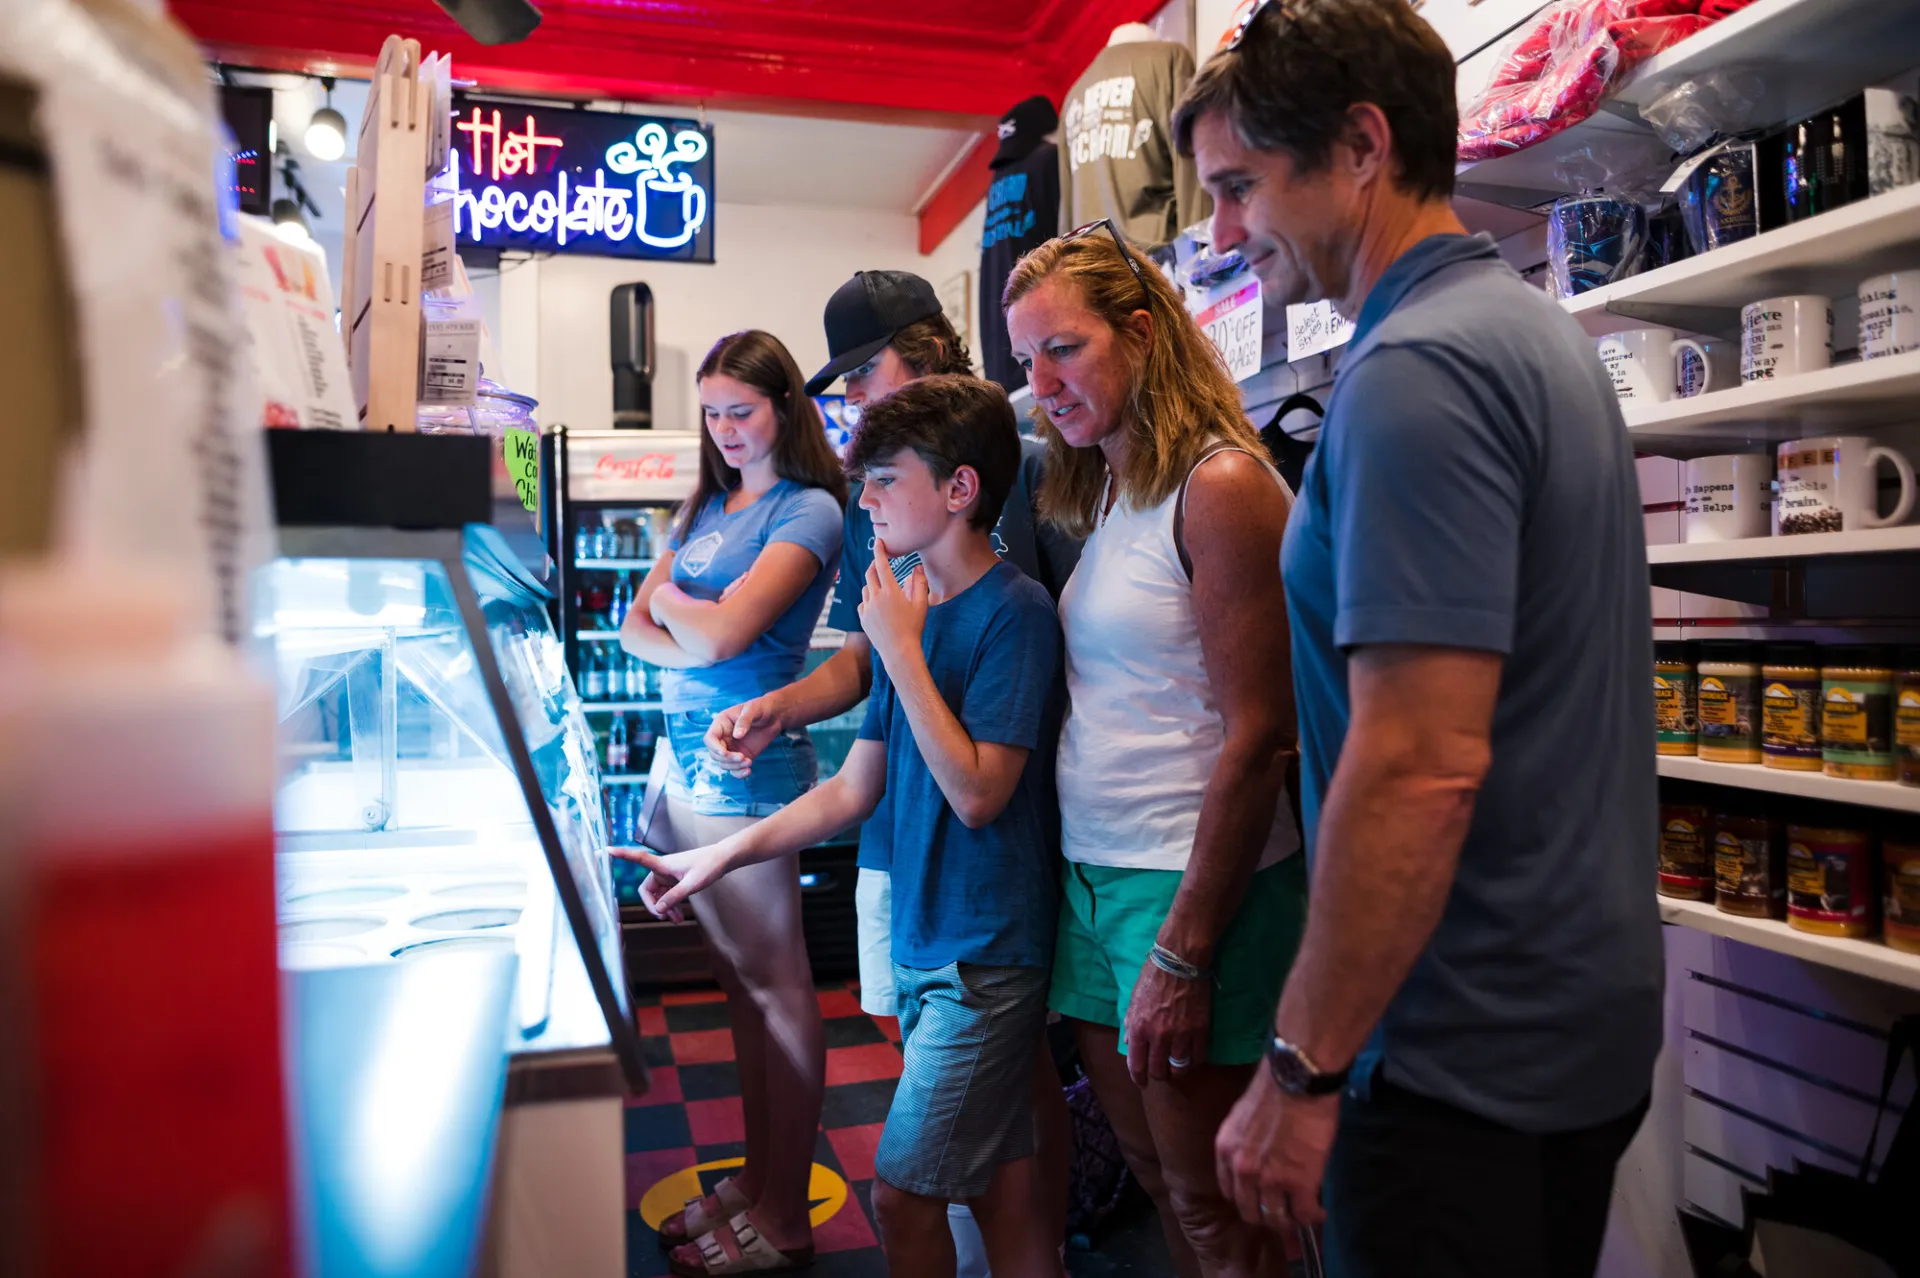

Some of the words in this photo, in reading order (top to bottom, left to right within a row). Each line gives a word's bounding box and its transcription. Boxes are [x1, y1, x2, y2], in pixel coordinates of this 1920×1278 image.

[456, 106, 564, 181] Hot
[449, 147, 633, 246] hocolate
[1213, 295, 1238, 317] SALE
[1235, 311, 1257, 342] OFF
[1602, 348, 1616, 357] ave
[1603, 352, 1633, 363] easured
[1693, 483, 1735, 494] Happens
[1702, 503, 1734, 515] Helps
